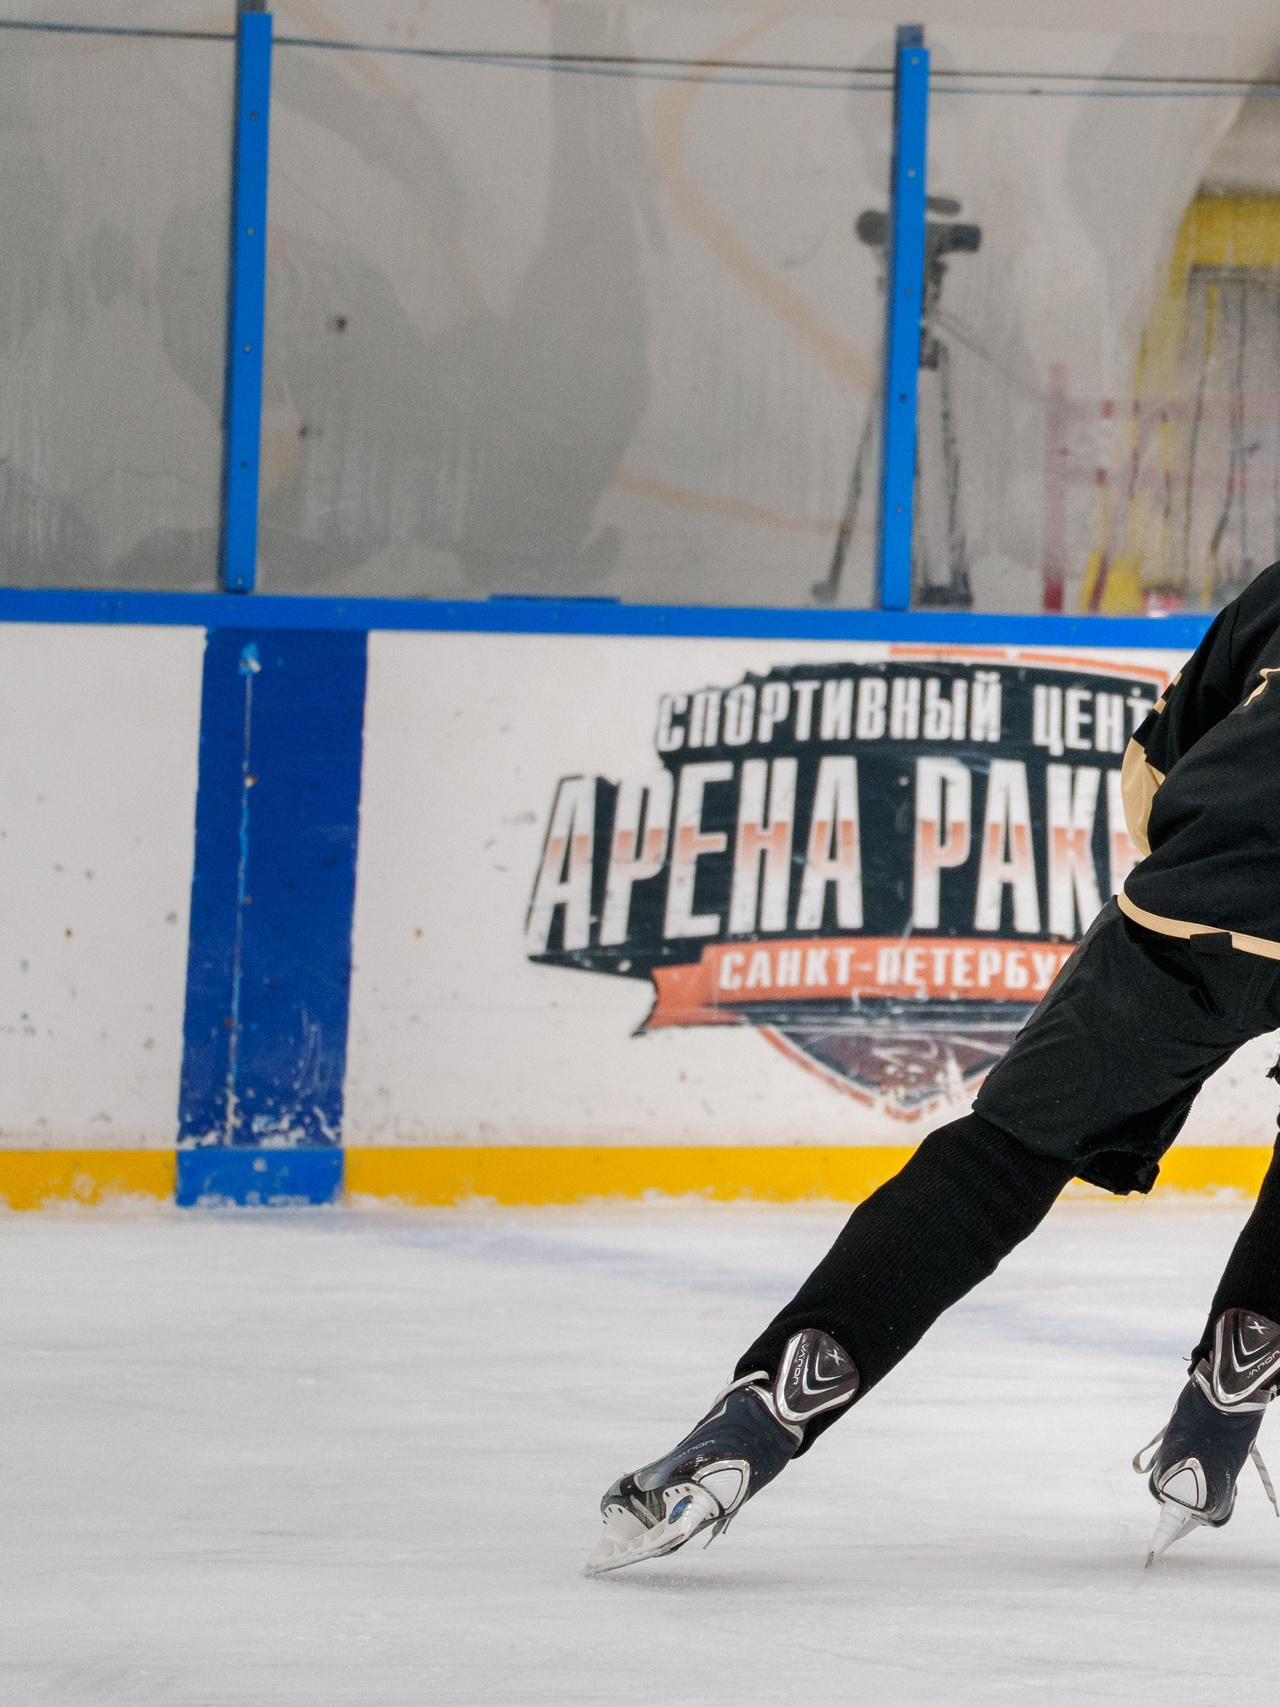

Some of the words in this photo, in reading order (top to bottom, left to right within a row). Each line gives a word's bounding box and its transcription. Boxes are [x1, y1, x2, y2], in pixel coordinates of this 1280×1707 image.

[656, 671, 1001, 753] СПОРТИВНЫЙ
[526, 755, 864, 953] АРЕНА
[719, 945, 1068, 991] САНКТ-ПЕТЕРБУ
